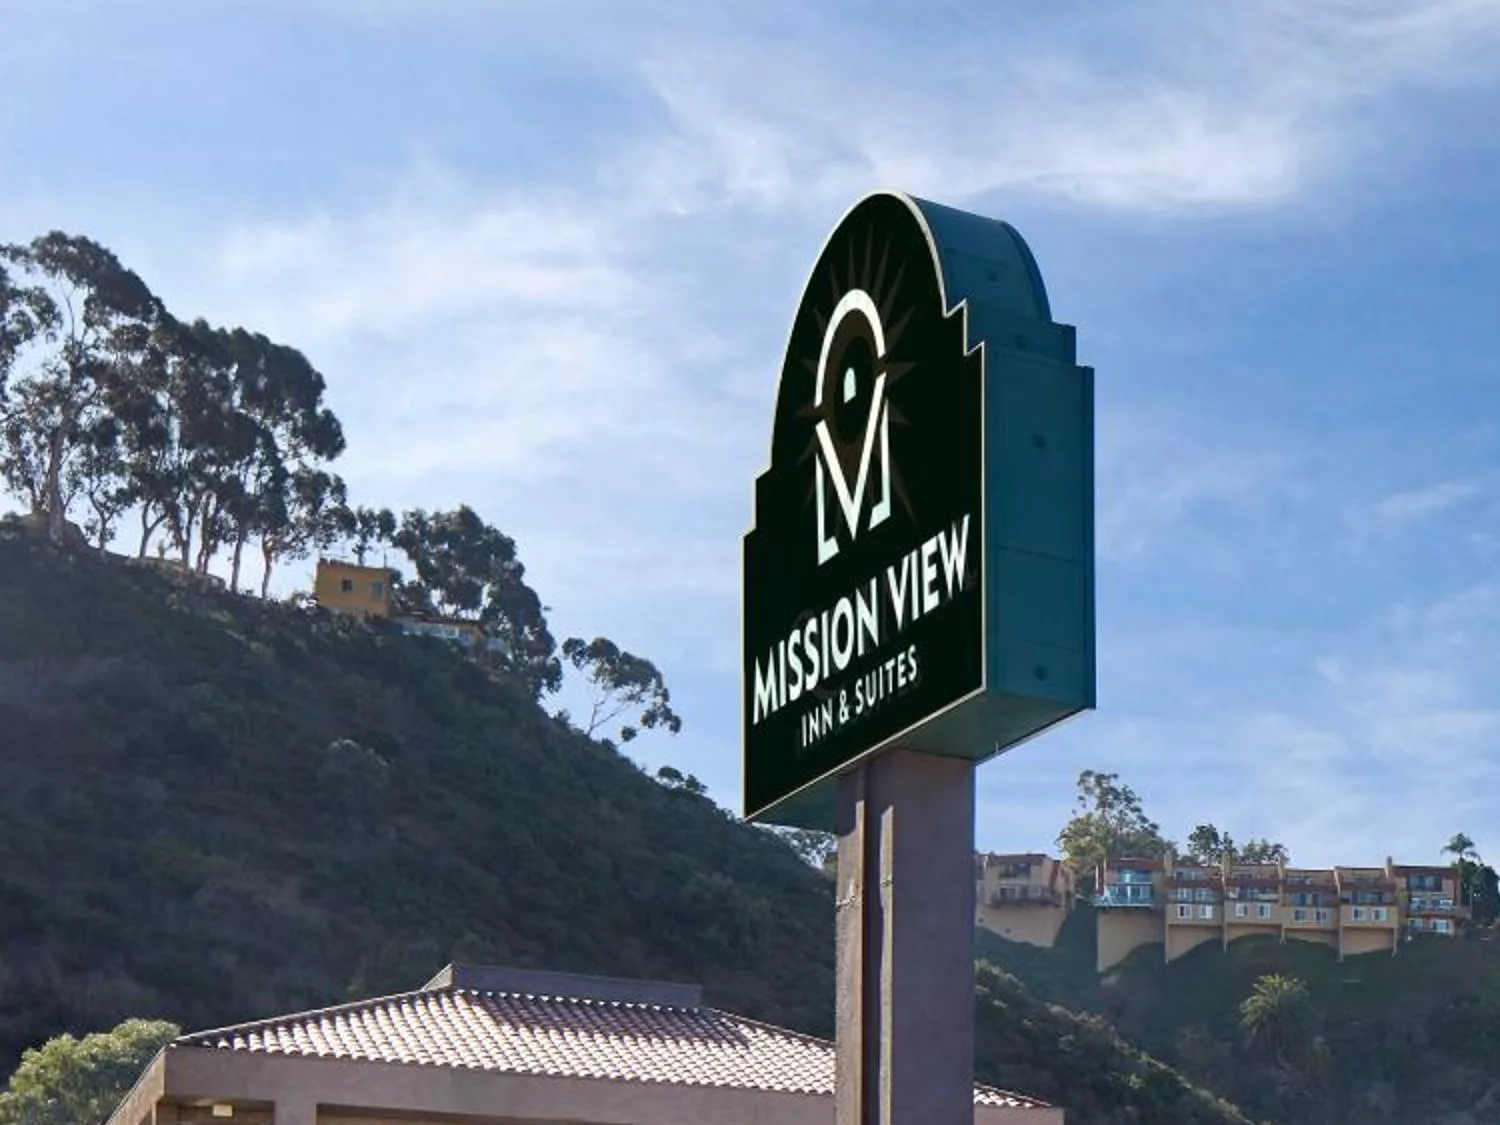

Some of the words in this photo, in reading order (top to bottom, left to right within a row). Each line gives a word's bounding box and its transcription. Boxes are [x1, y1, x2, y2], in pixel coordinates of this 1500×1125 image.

[752, 576, 880, 726] MISSION
[886, 512, 971, 632] VIEW
[800, 698, 834, 748] INN
[838, 689, 850, 725] &
[854, 643, 918, 716] SUITES
